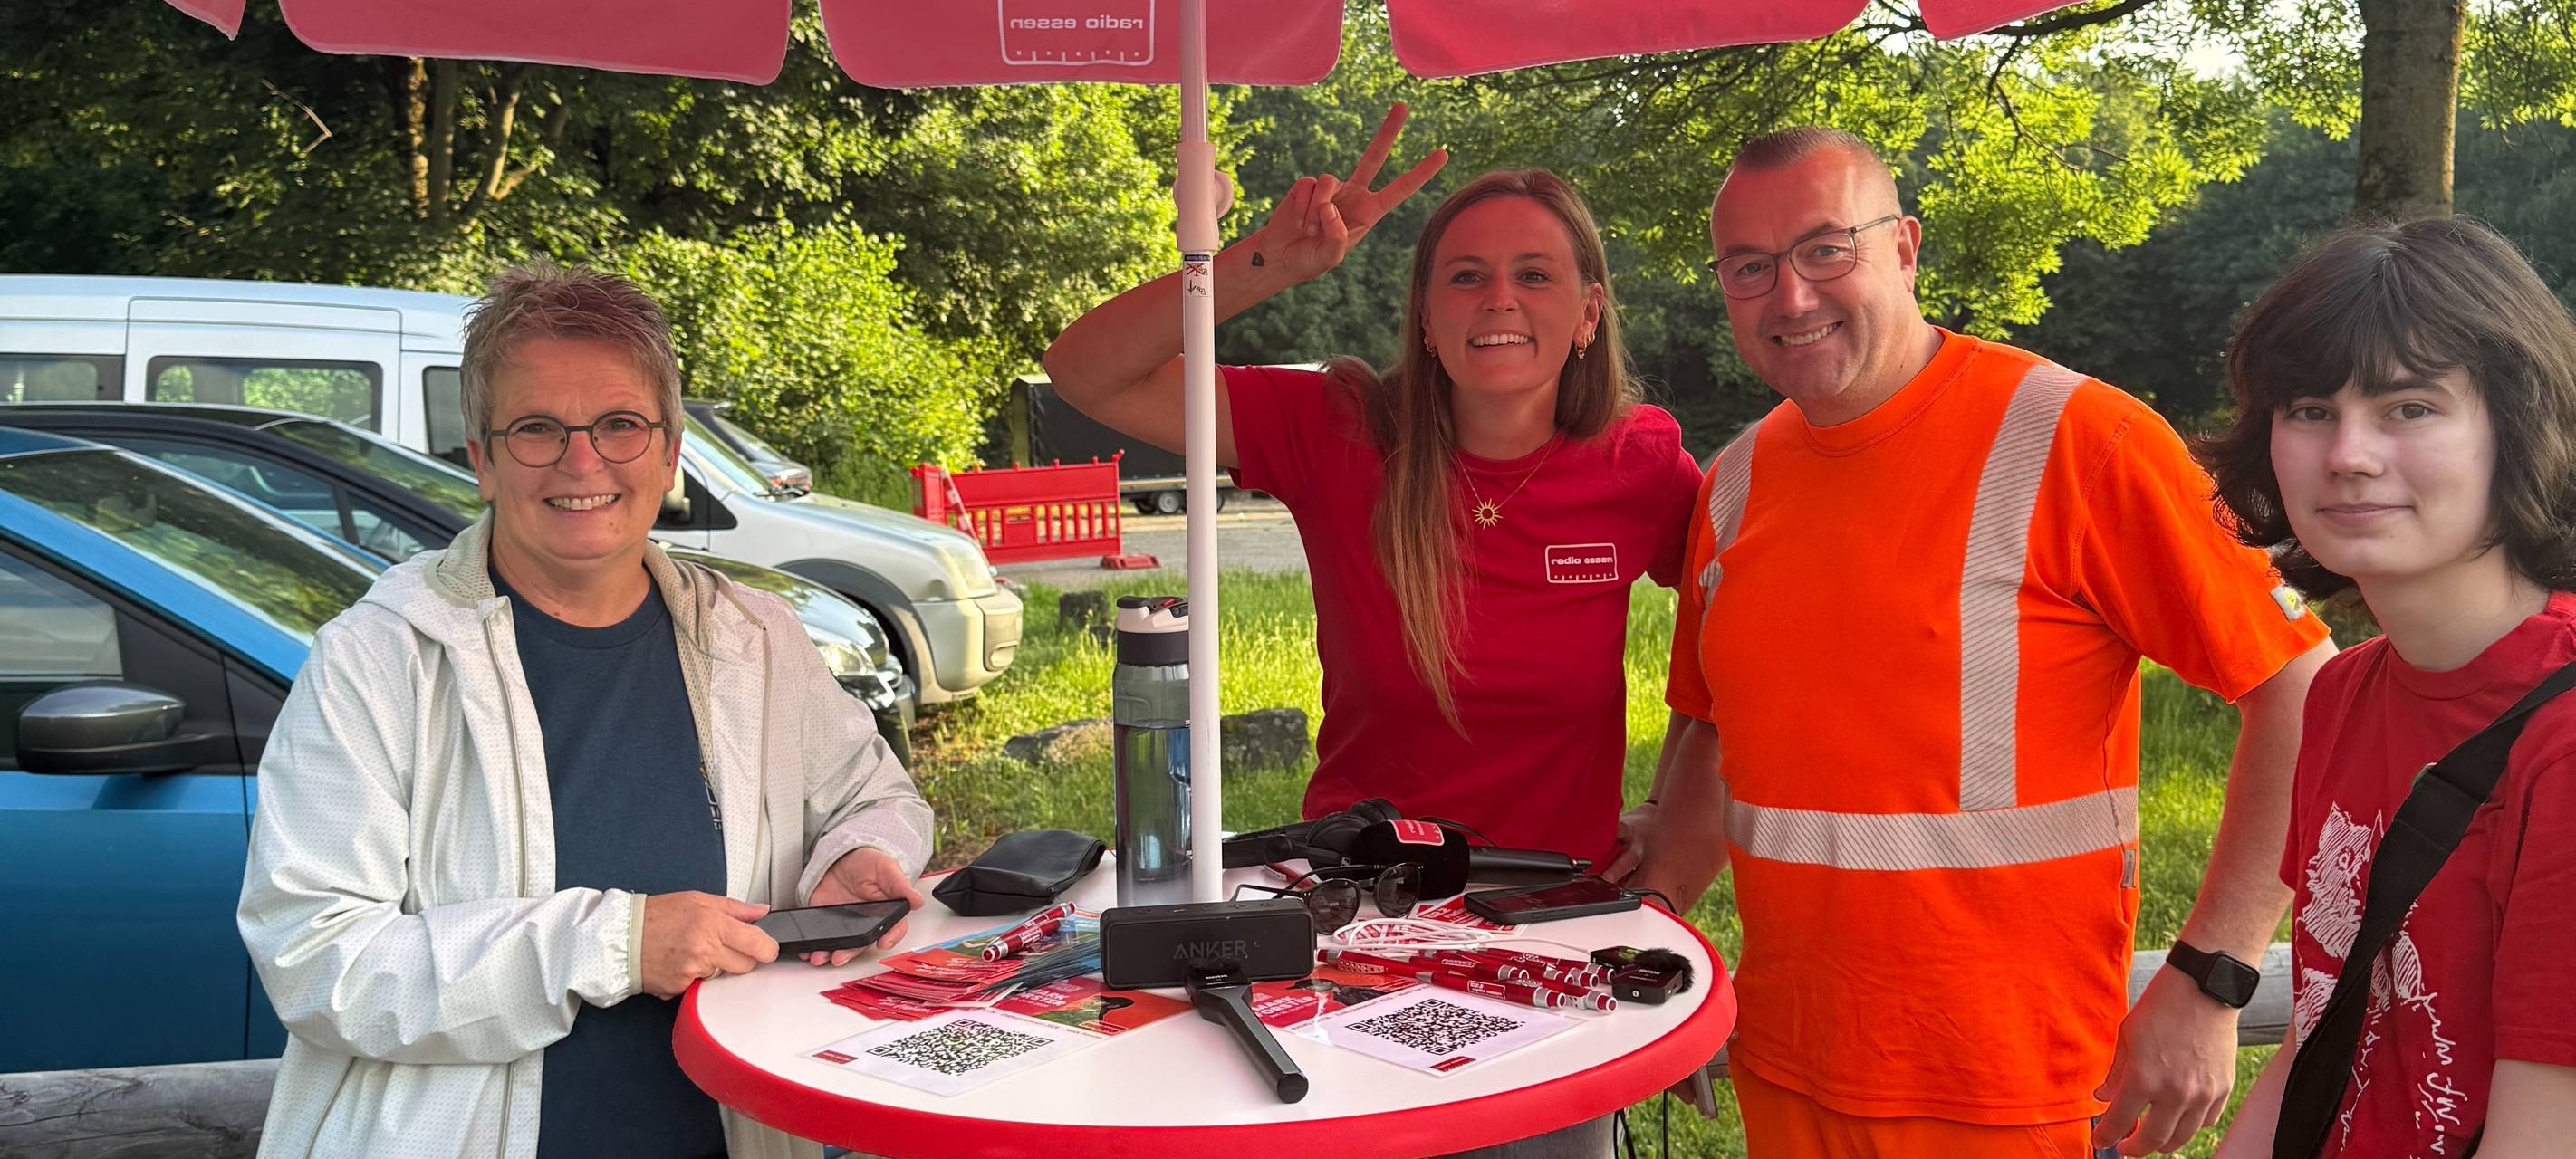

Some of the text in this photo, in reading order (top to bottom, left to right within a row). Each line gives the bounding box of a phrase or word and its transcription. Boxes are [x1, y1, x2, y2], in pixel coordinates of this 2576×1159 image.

[1551, 556, 1613, 565] radio essen
[1173, 940, 1248, 960] ANKER
